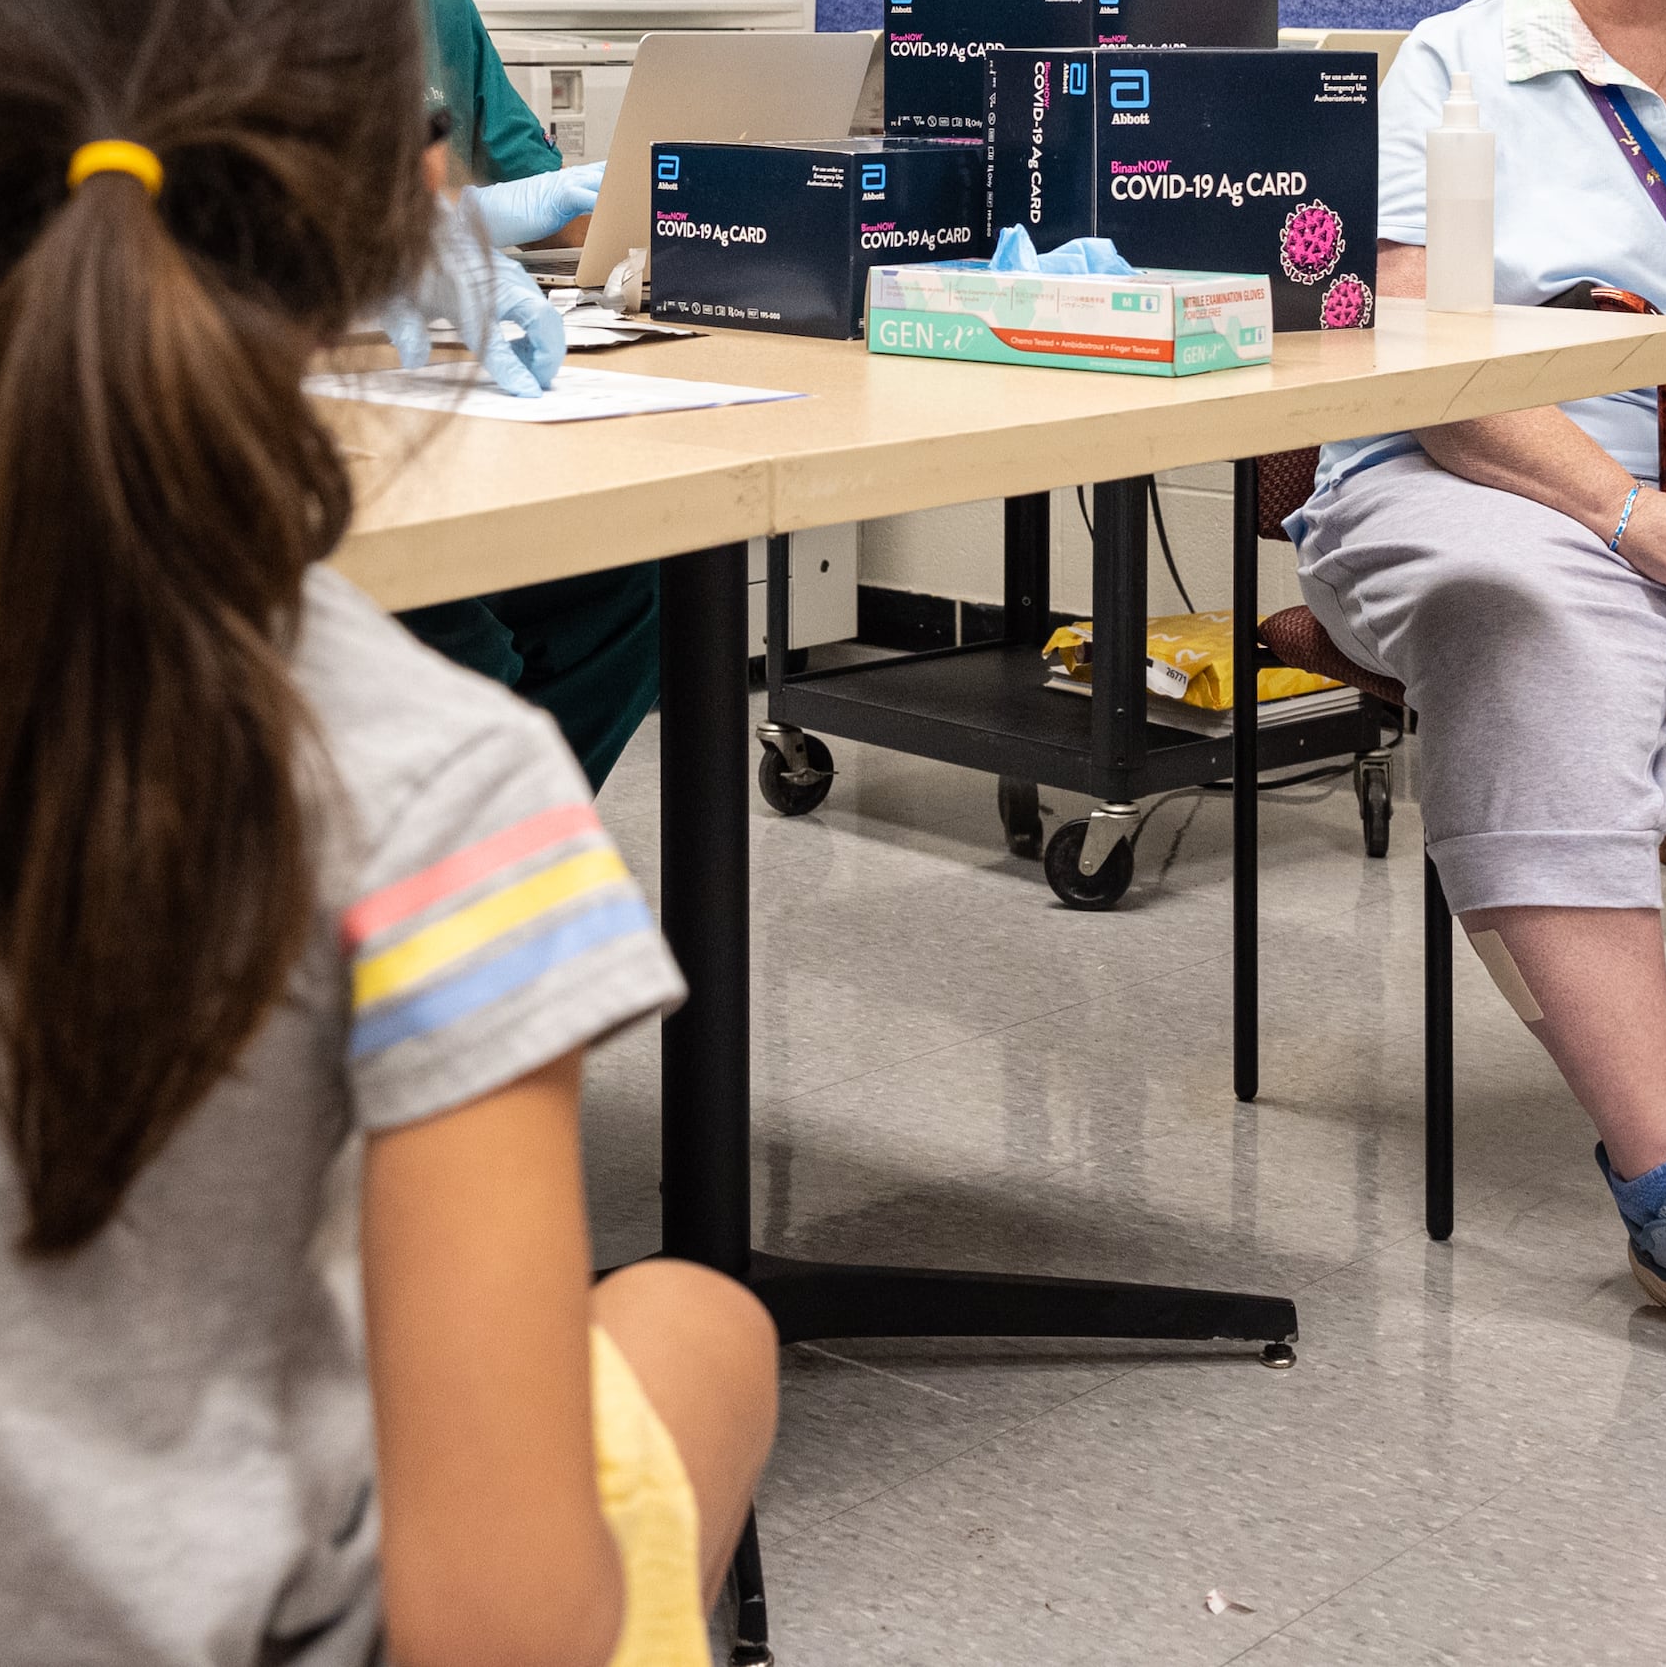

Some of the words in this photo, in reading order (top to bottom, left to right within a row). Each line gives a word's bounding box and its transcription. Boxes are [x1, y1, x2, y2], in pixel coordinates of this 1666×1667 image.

[891, 6, 913, 15] Abbott
[890, 42, 948, 57] COVID-19
[949, 43, 966, 62] Ag
[1062, 63, 1070, 95] Abbott
[1320, 72, 1331, 80] For
[1342, 72, 1359, 80] under
[1323, 83, 1355, 94] Emergency
[1355, 83, 1367, 91] Use
[1032, 61, 1045, 145] COVID-19
[1314, 94, 1353, 102] Authorization
[1353, 94, 1367, 104] only.
[1111, 112, 1150, 125] Abbott
[1028, 147, 1044, 169] Ag
[657, 182, 679, 191] Abbott
[1110, 174, 1213, 201] COVID-19
[1216, 175, 1244, 207] Ag
[1246, 171, 1307, 197] CARD
[862, 192, 885, 201] Abbott
[1029, 170, 1042, 224] CARD
[656, 220, 711, 240] COVID-19
[713, 227, 729, 247] Ag
[729, 226, 767, 244] CARD
[861, 231, 919, 250] COVID-19
[920, 230, 935, 250] Ag
[936, 227, 971, 244] CARD
[1121, 298, 1133, 309] M
[1183, 295, 1204, 309] NITRILE
[1205, 291, 1243, 306] EXAMINATION
[1244, 289, 1265, 302] GLOVES
[1010, 336, 1033, 347] Chemo
[1034, 338, 1055, 348] Tested
[1061, 339, 1104, 351] Ambidextrous
[1110, 344, 1130, 355] Finger
[1131, 345, 1160, 355] Textured
[1166, 666, 1187, 684] 26771
